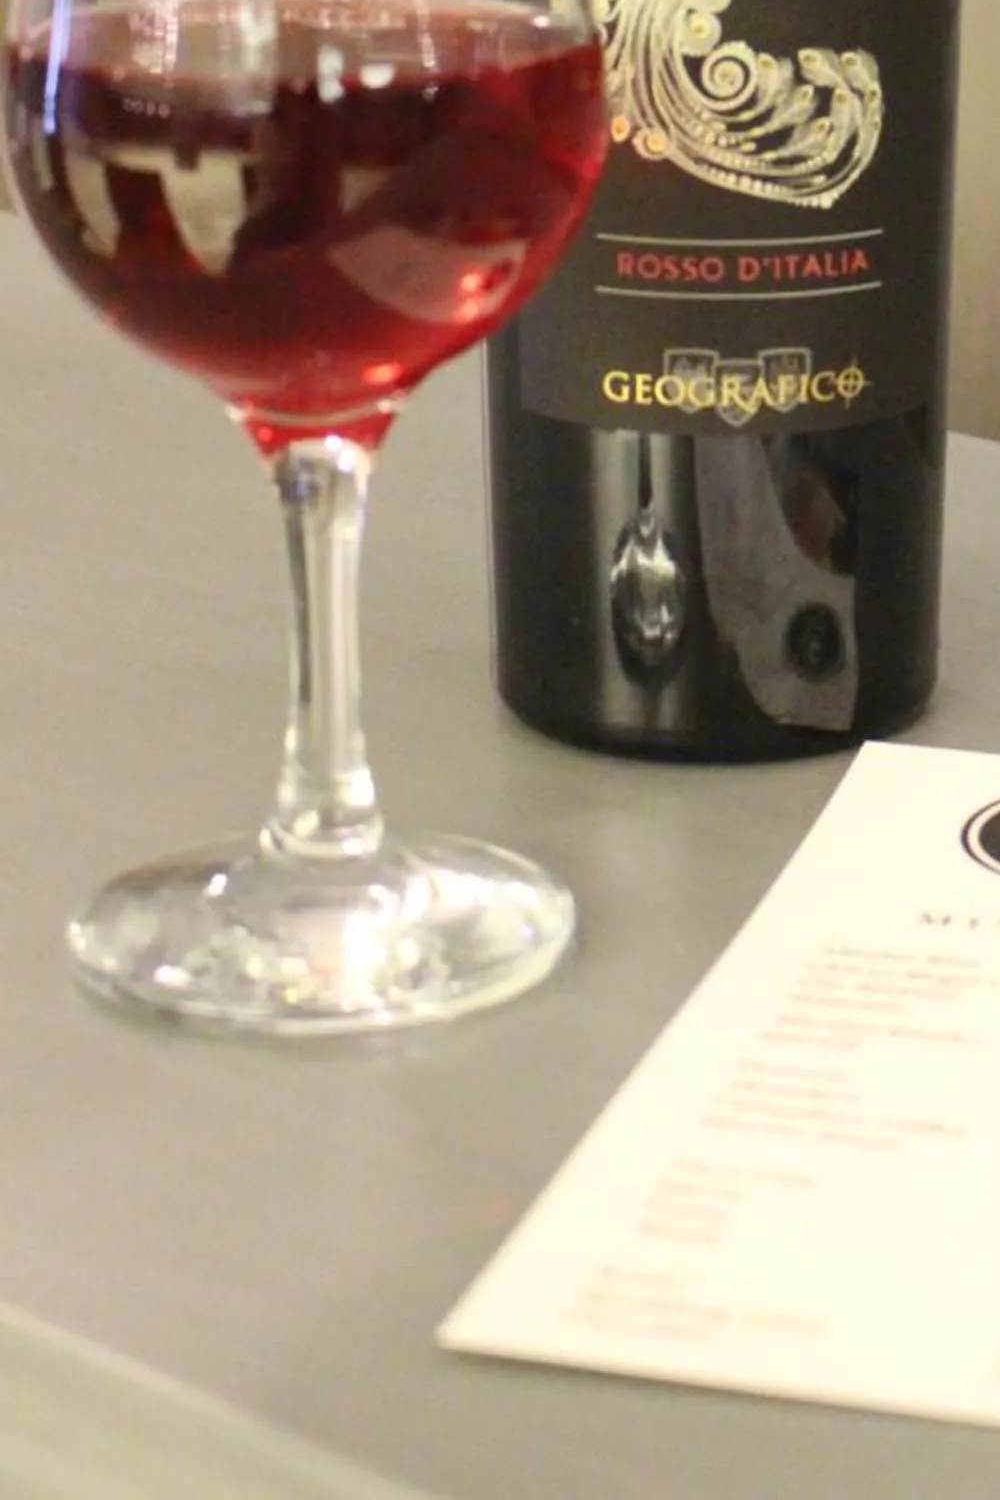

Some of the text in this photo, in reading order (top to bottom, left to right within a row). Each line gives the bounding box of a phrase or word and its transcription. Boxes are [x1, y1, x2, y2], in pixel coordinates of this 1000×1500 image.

[616, 249, 869, 284] ROSSO D'ITALIA
[602, 358, 870, 412] GEOGRAFICO
